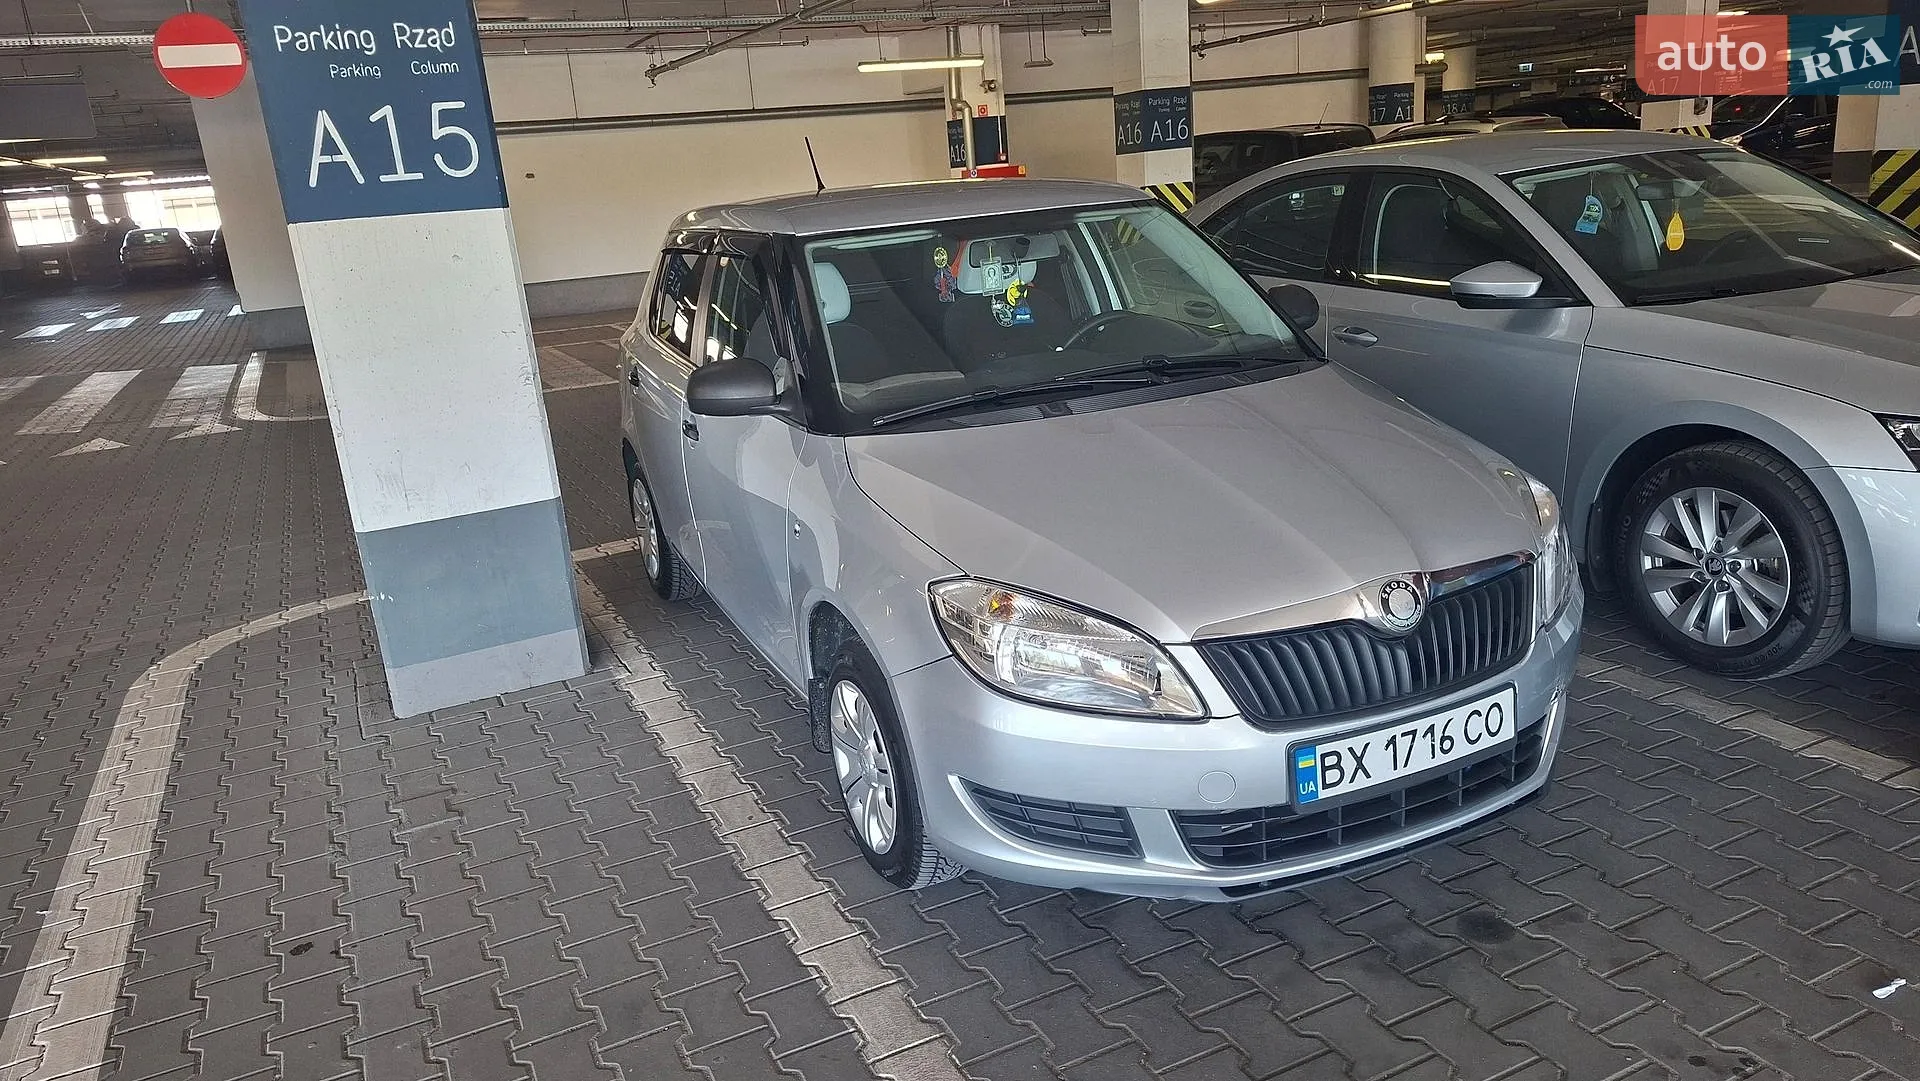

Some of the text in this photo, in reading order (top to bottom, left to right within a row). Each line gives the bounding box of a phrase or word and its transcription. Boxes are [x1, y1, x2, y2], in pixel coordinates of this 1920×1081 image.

[273, 22, 456, 55] Parking Rząd
[329, 60, 460, 79] Parking Column
[1117, 121, 1143, 147] A16
[1150, 117, 1189, 143] A16
[308, 100, 479, 188] A15
[950, 143, 966, 162] A16
[1319, 702, 1504, 791] BX 1716 CO
[1299, 780, 1317, 795] UA
